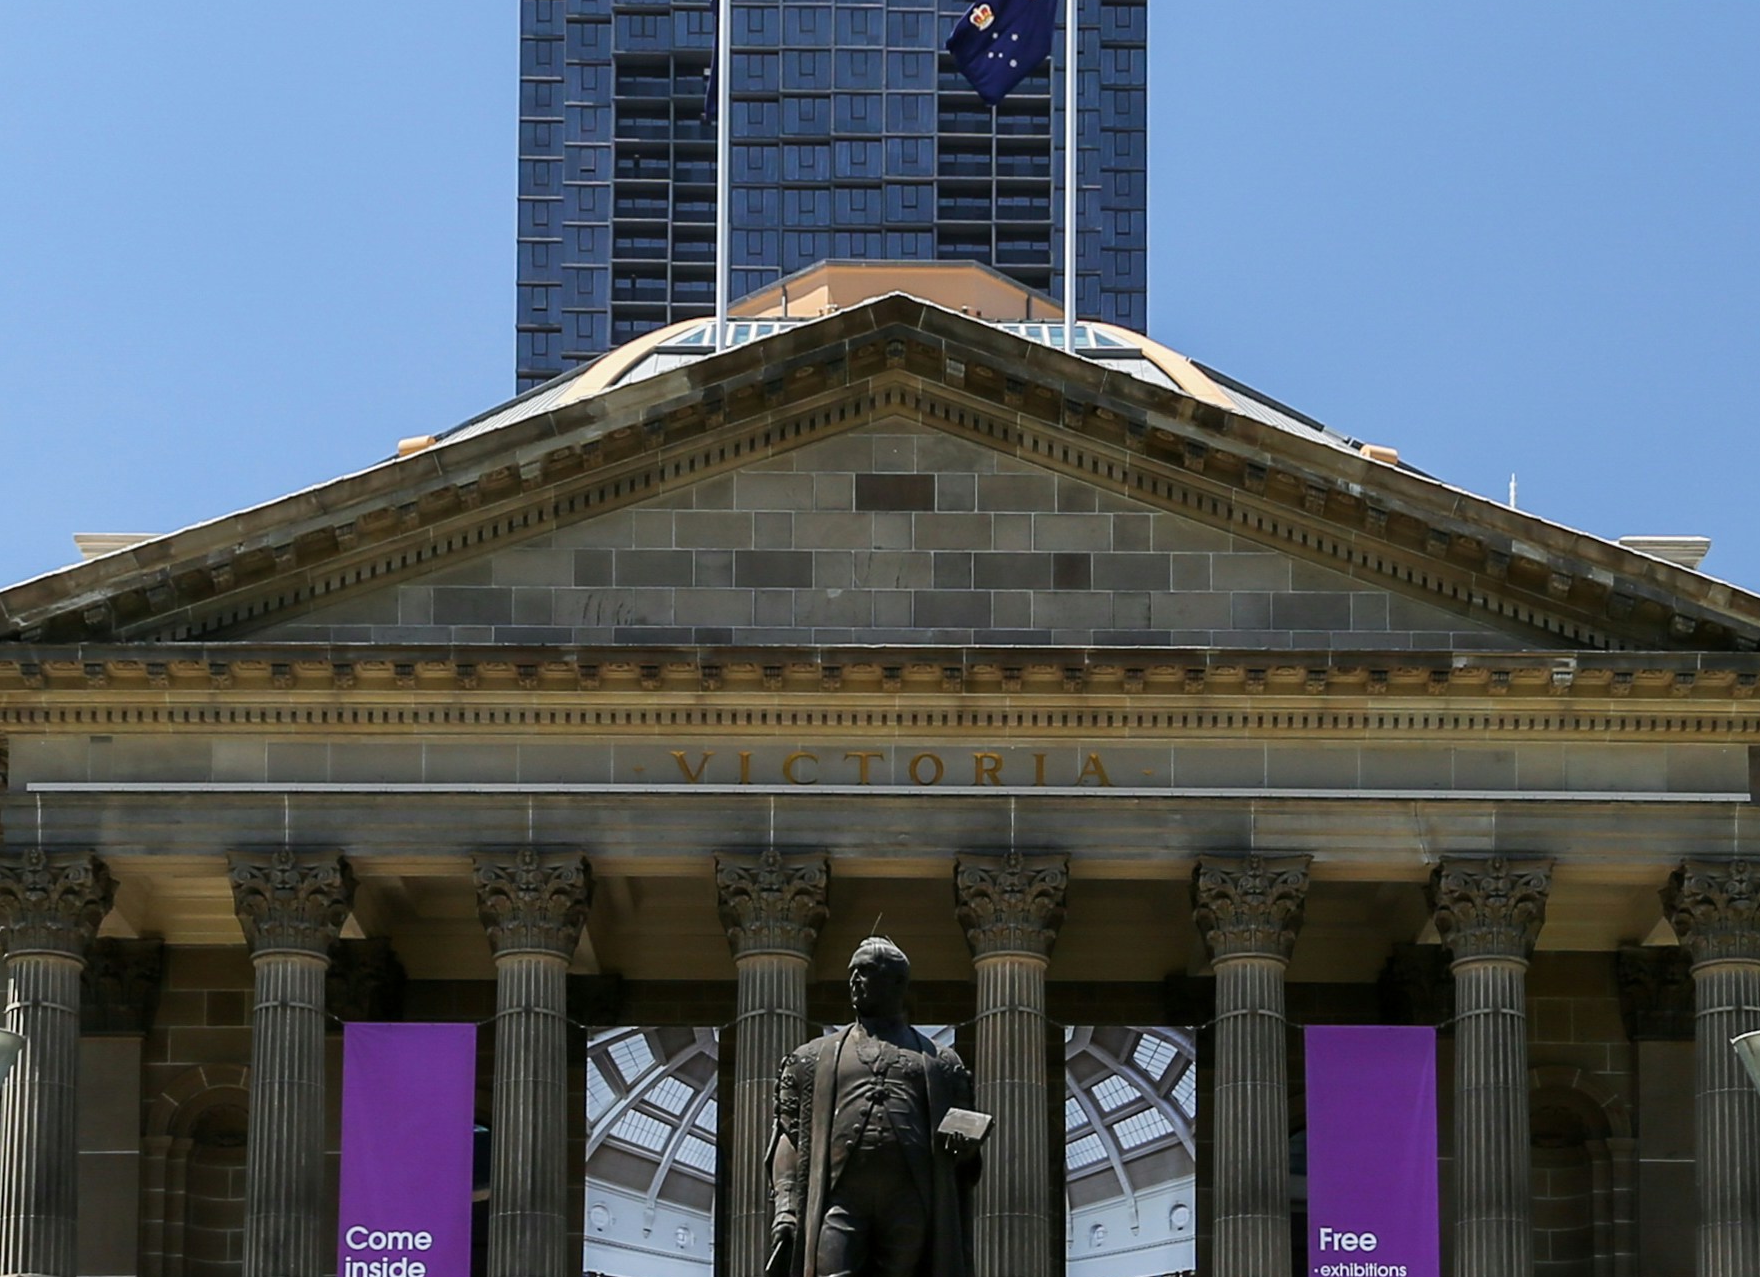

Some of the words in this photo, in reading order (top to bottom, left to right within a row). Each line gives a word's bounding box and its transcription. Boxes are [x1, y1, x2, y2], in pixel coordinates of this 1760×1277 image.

[670, 750, 1113, 787] VICTORIA
[345, 1225, 433, 1251] Come
[1319, 1227, 1378, 1252] Free
[1320, 1262, 1407, 1277] exhibitions
